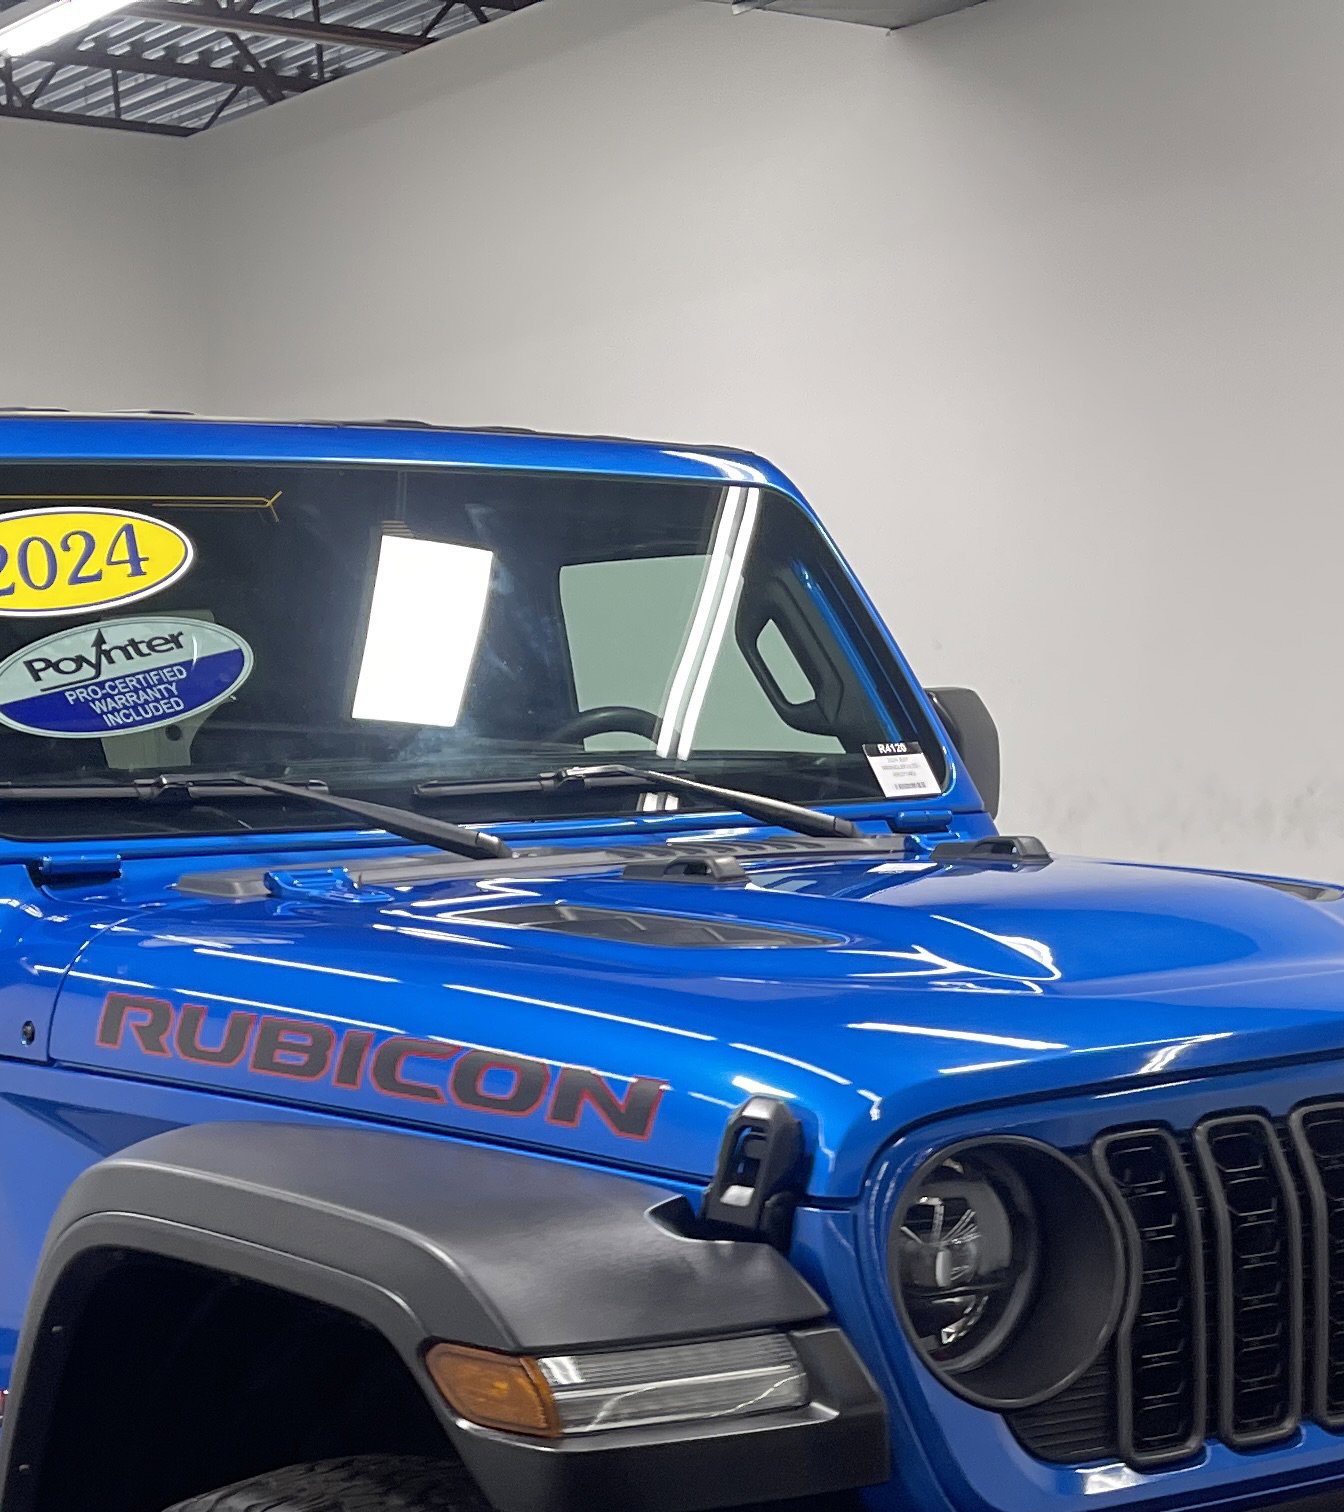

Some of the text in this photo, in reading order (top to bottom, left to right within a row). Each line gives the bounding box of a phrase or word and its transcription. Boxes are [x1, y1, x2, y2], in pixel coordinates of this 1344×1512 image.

[23, 628, 185, 691] Poynter
[64, 665, 188, 705] PRO-CERTIFIED
[89, 682, 180, 714] WARRANTY
[102, 697, 185, 727] INCLUDED
[96, 992, 670, 1141] RUBICON
